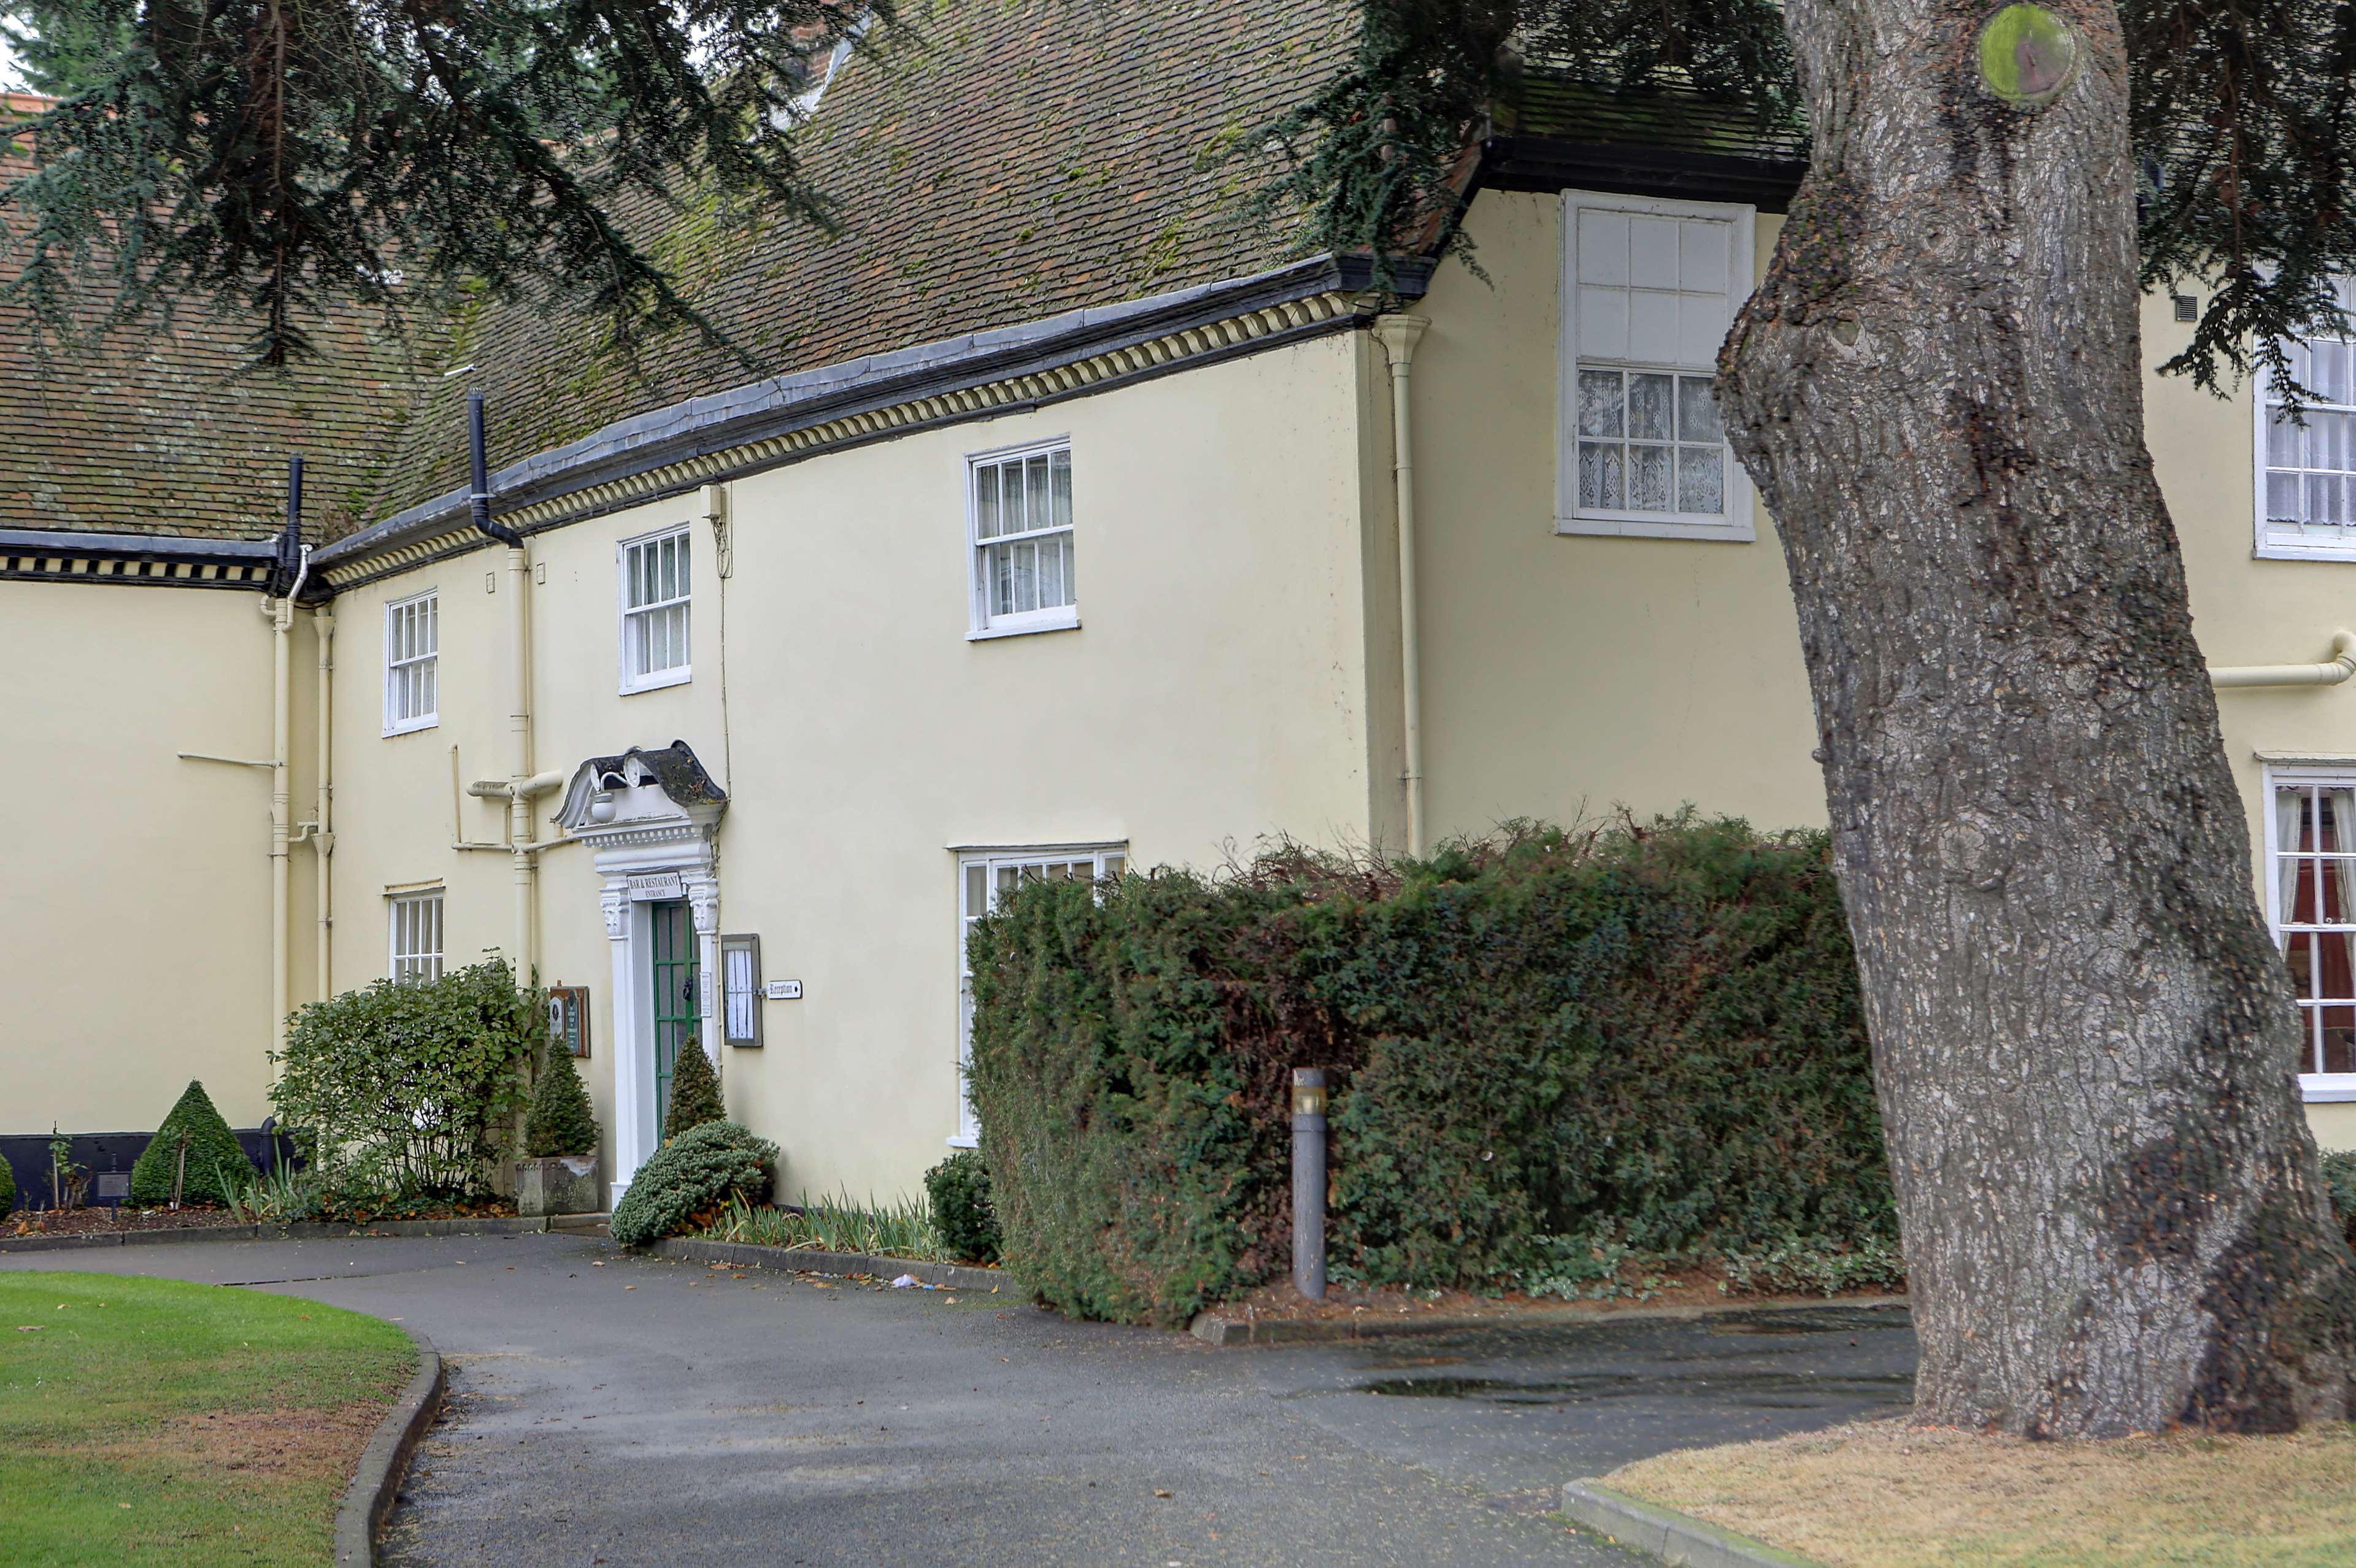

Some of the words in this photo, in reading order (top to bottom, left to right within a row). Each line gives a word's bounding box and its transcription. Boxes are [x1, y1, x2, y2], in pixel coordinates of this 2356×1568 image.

[629, 879, 640, 889] BAR
[641, 879, 645, 888] &
[645, 876, 679, 888] RESTAURANT
[769, 983, 793, 995] Reception
